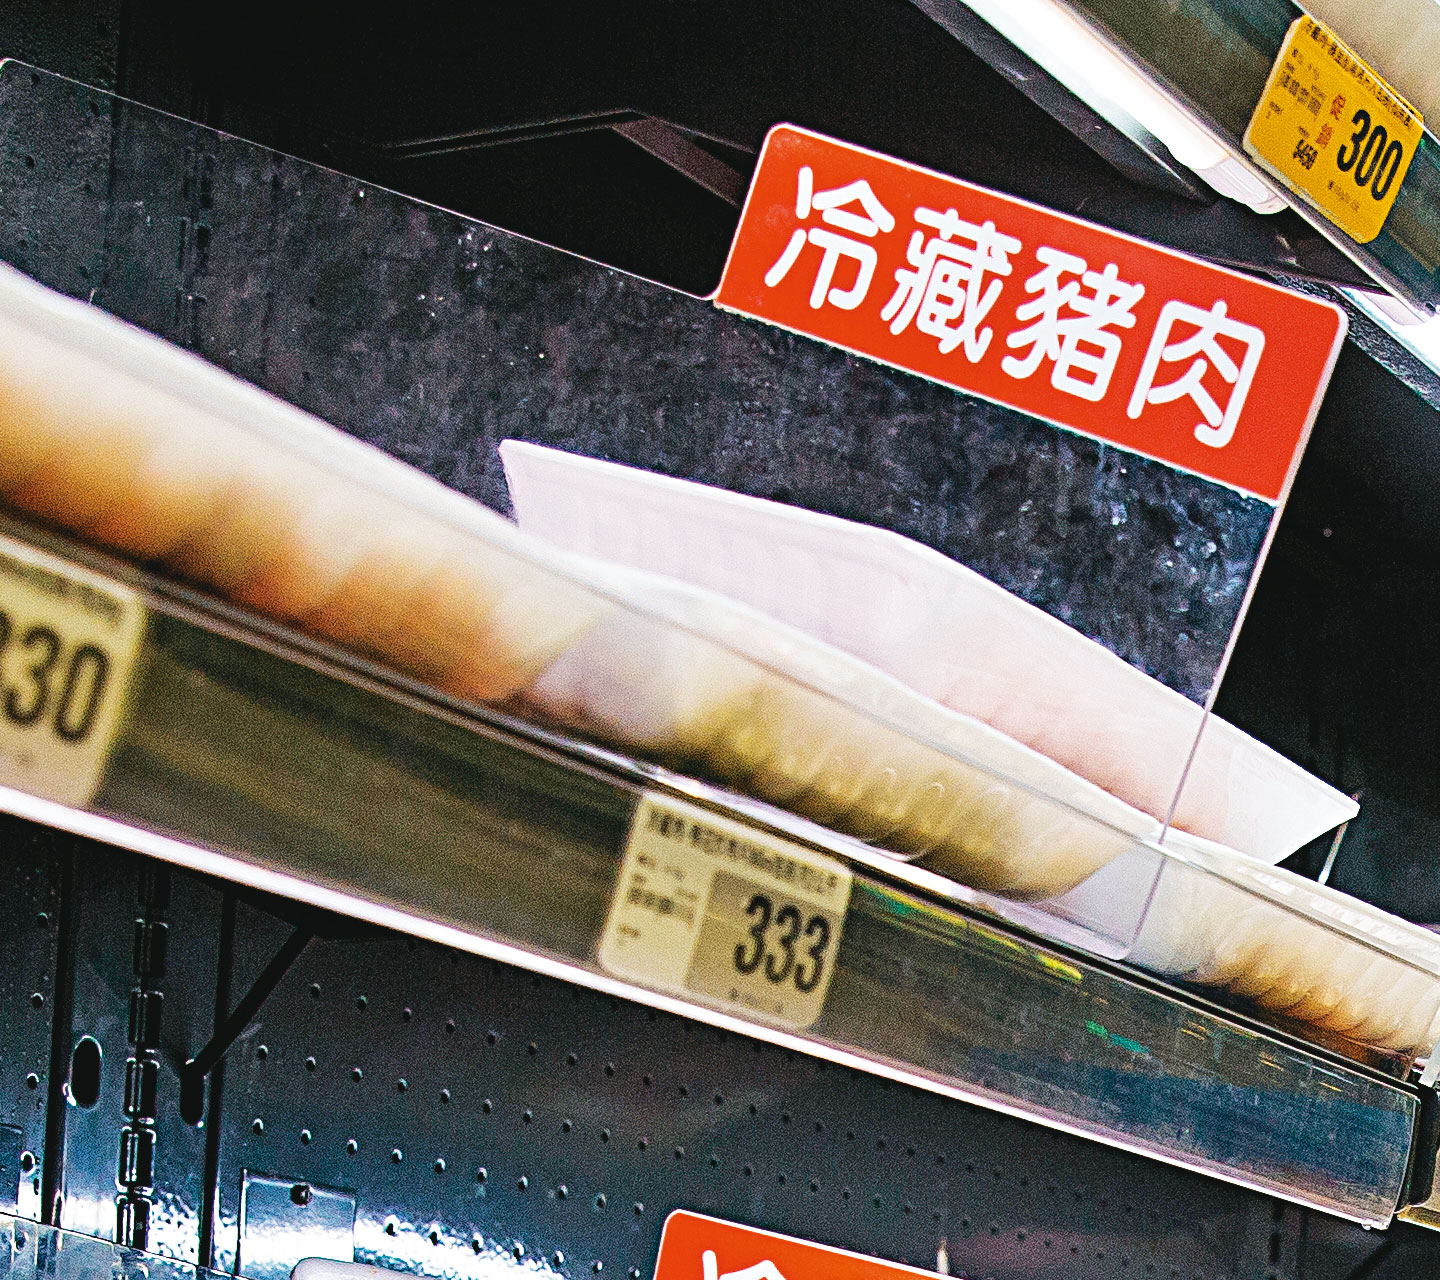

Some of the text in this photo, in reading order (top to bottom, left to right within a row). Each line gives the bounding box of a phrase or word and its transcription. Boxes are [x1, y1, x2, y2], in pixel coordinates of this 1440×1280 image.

[1337, 109, 1402, 200] 300
[764, 165, 1266, 448] 冷藏豬肉
[735, 892, 831, 994] 333
